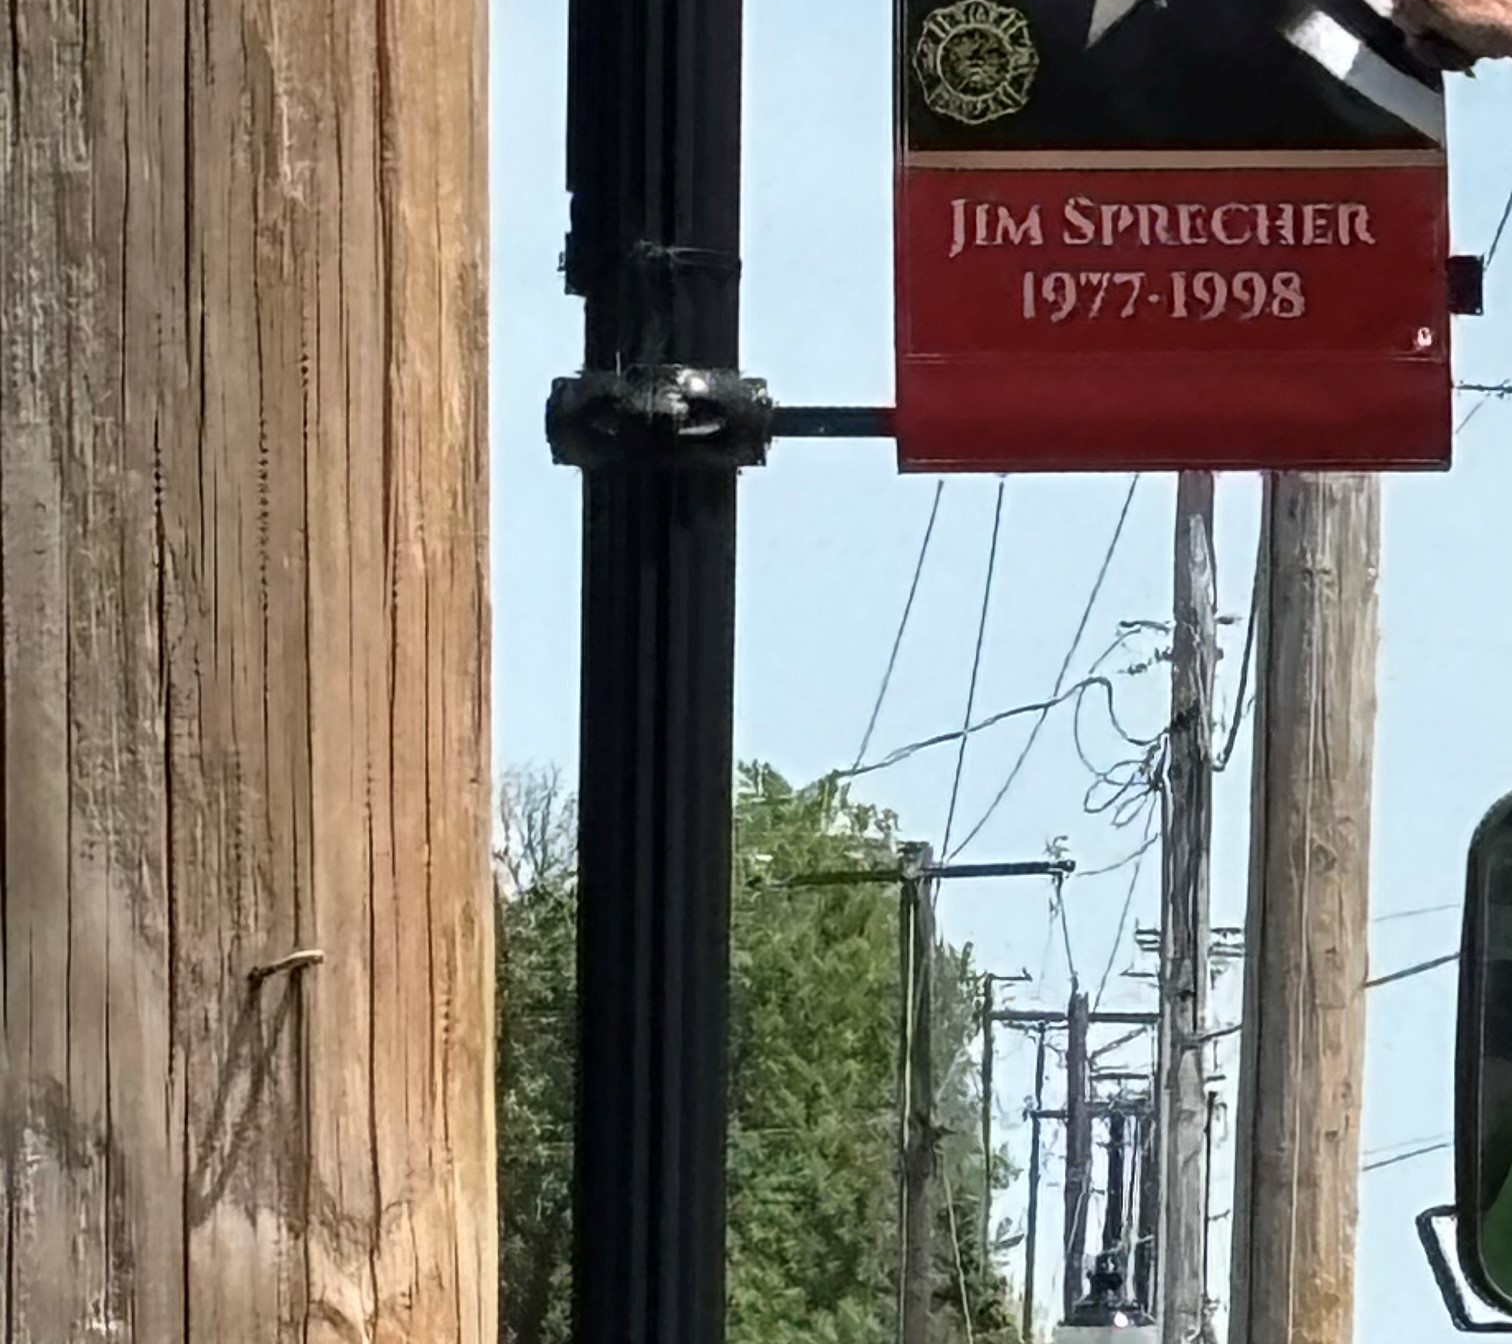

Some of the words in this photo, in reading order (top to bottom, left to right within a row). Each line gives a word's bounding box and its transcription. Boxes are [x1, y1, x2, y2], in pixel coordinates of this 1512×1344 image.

[948, 197, 1044, 258] JIM
[1062, 196, 1377, 246] SPRECHER
[1022, 270, 1306, 323] 1977-1998
